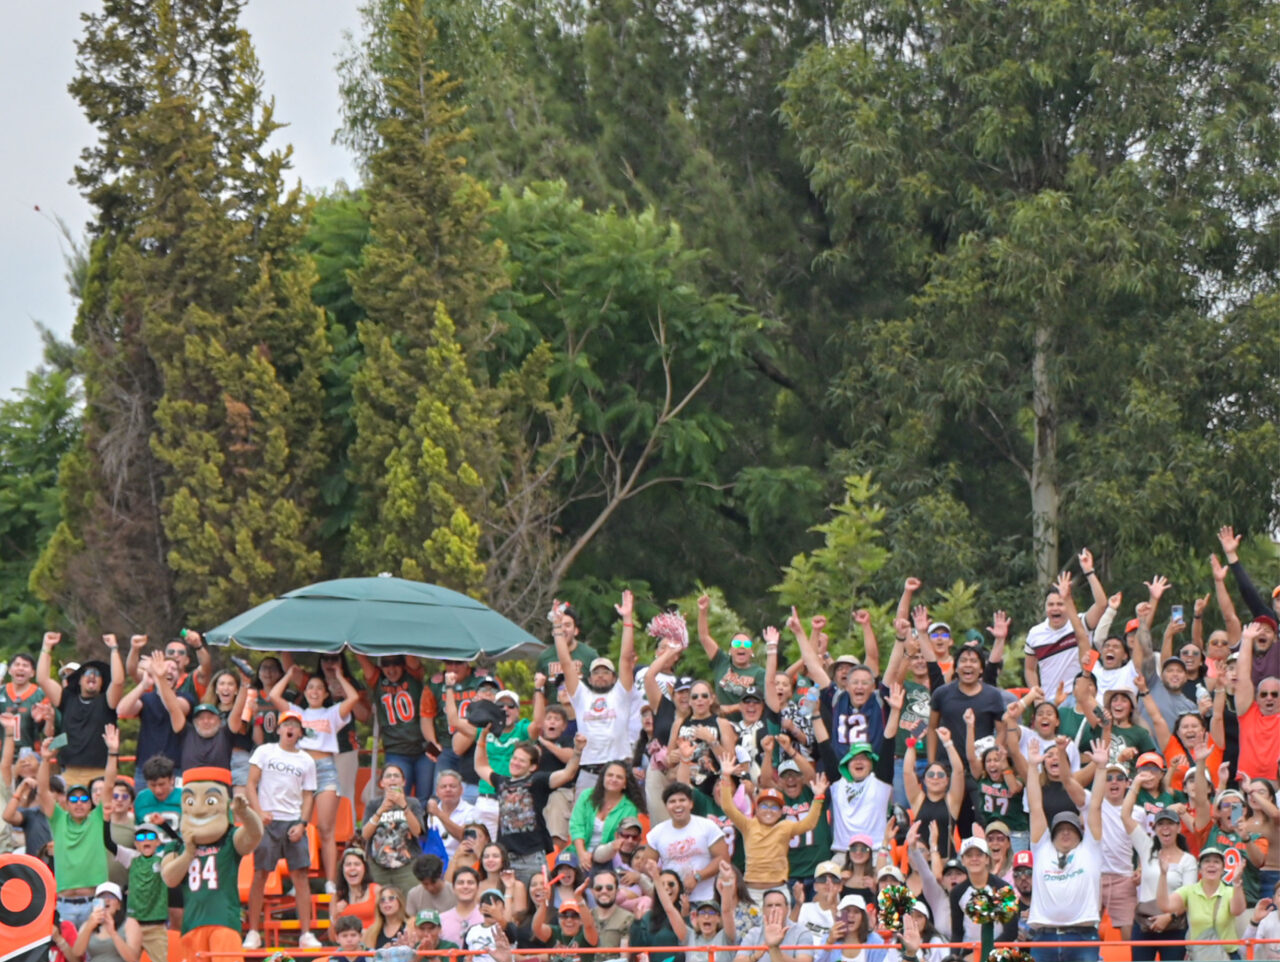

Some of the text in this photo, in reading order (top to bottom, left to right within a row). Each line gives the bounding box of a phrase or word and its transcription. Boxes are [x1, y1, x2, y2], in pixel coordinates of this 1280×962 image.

[381, 691, 416, 726] 10
[837, 714, 868, 744] 12
[268, 759, 305, 777] KORS
[188, 856, 219, 892] 84
